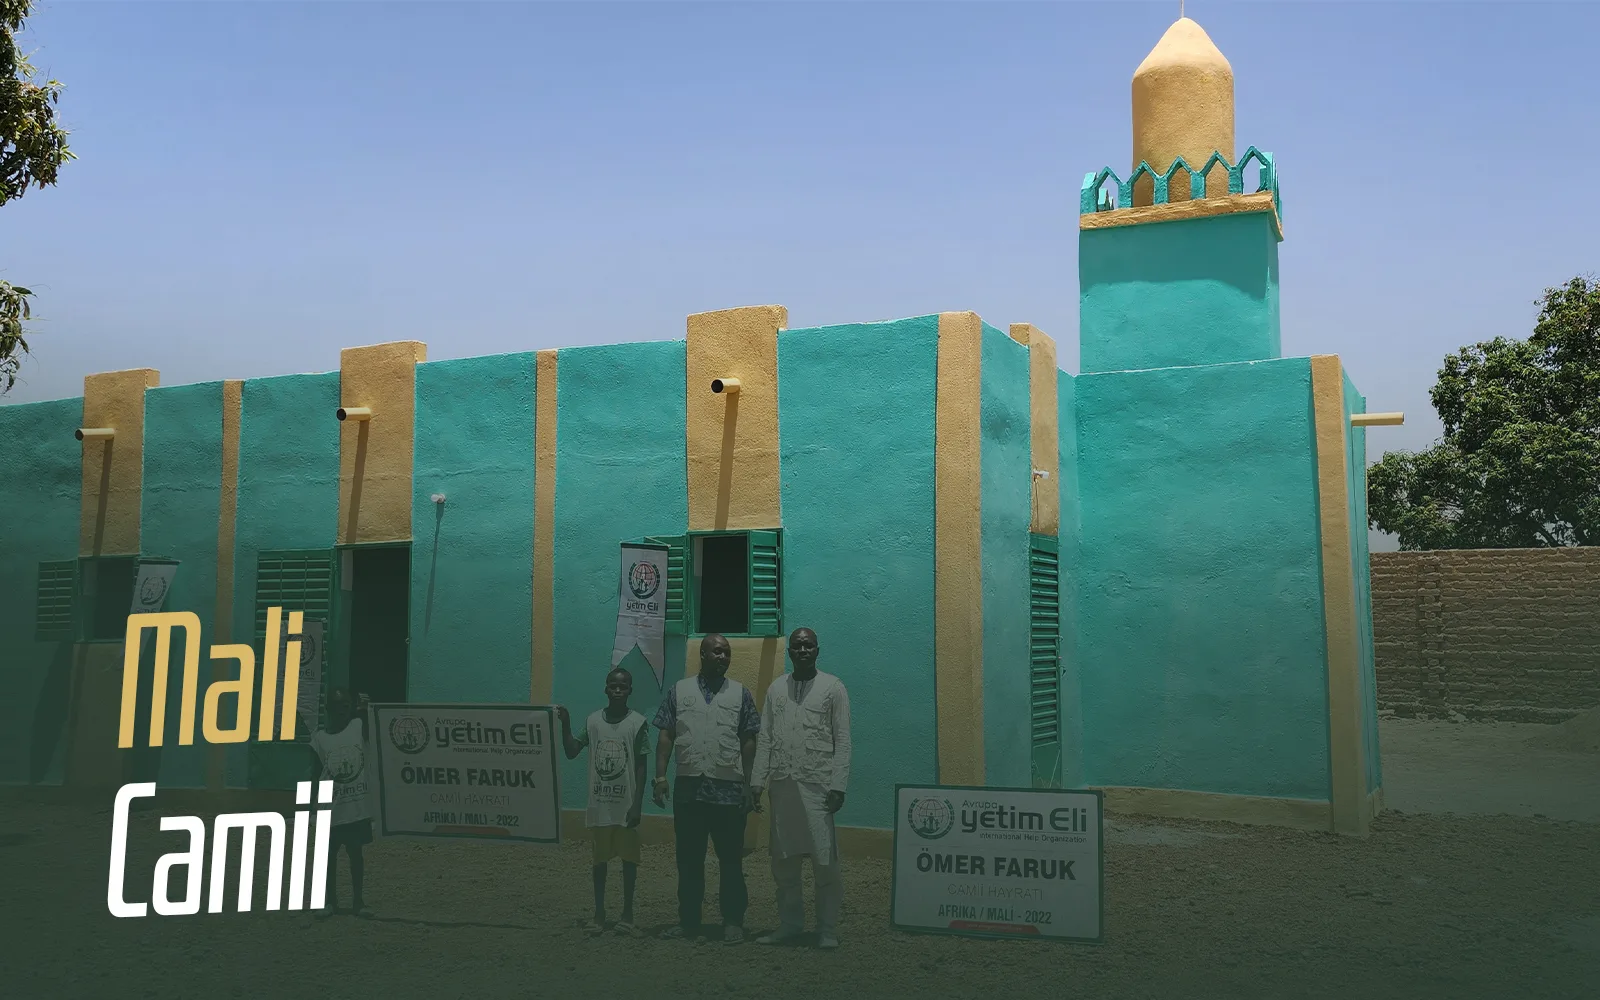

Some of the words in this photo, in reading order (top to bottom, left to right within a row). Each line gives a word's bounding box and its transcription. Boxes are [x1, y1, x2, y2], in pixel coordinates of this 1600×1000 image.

[434, 722, 506, 748] yetim
[510, 723, 543, 745] Eli
[400, 762, 461, 785] ÖMER
[466, 768, 536, 789] FARUK
[962, 799, 998, 810] Avrupa
[496, 814, 520, 827] 2022
[961, 805, 1044, 833] yetim
[1049, 807, 1087, 832] Eli
[980, 832, 1022, 841] International
[1041, 834, 1087, 844] Organization
[916, 847, 985, 875] ÖMER
[994, 856, 1077, 881] FARUK
[1025, 910, 1053, 924] 2022
